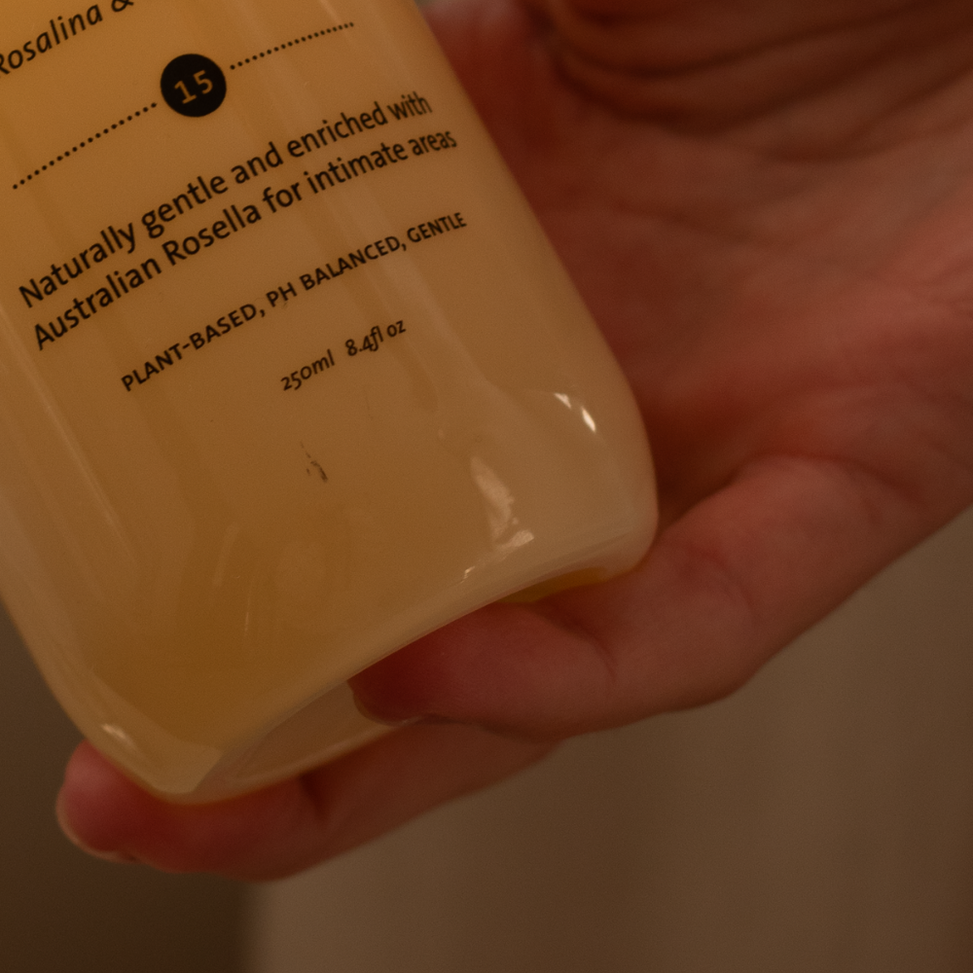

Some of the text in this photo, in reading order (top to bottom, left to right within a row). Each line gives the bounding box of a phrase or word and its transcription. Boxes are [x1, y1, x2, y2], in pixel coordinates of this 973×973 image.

[174, 70, 214, 104] 15
[19, 91, 433, 308] Naturally gentle and enriched with
[34, 129, 458, 351] Australian Rosella for intimate areas
[120, 212, 468, 392] PLANT-BASED, PH BALANCED, GENTLE
[280, 319, 407, 392] 250ml 8.4fl oz
